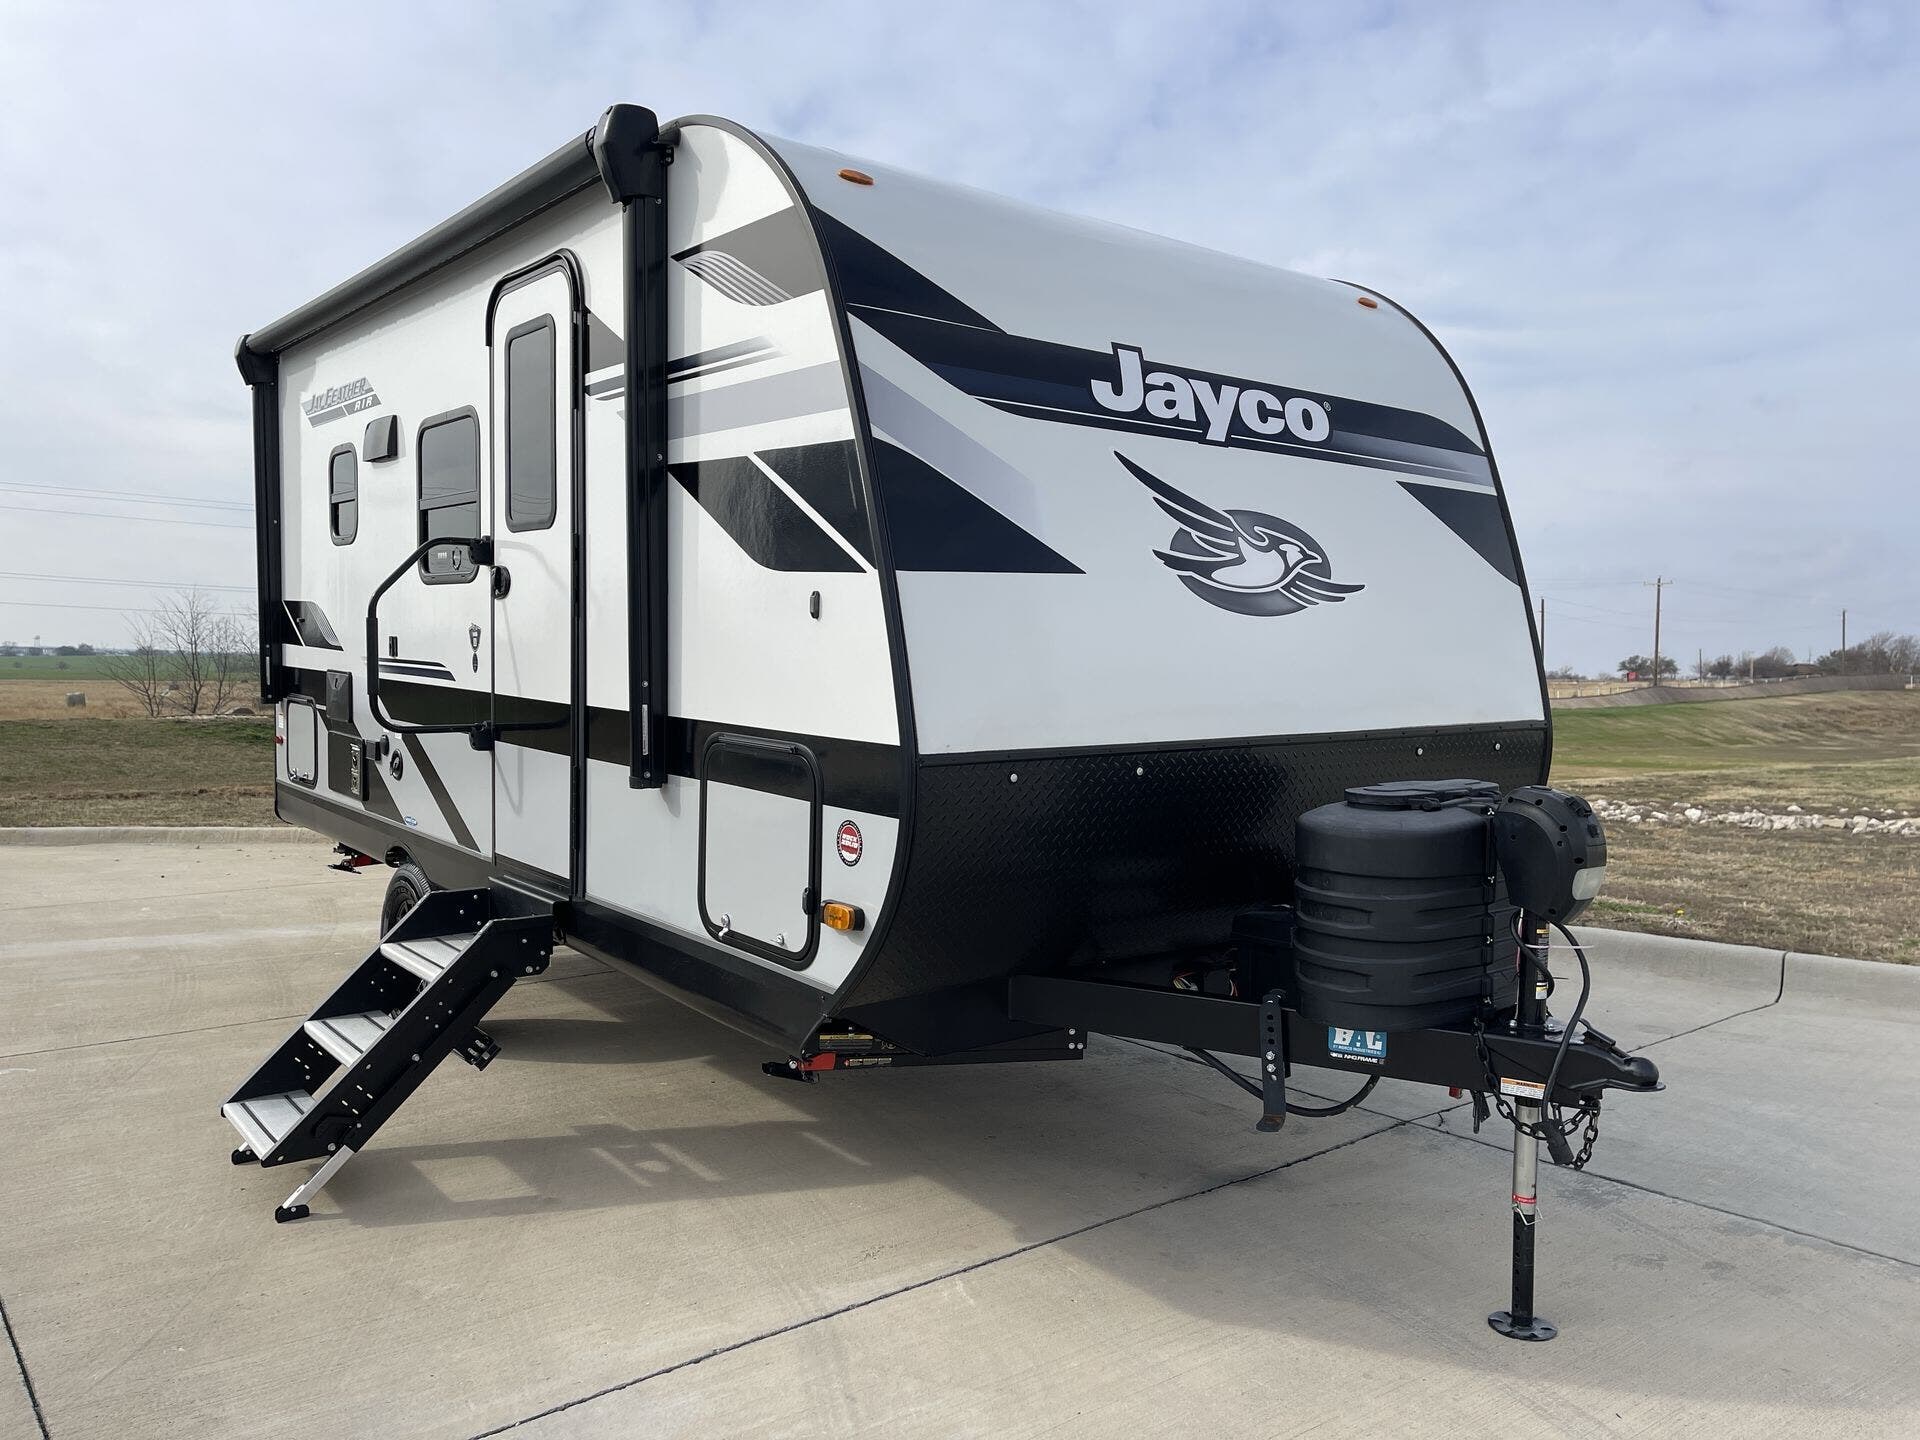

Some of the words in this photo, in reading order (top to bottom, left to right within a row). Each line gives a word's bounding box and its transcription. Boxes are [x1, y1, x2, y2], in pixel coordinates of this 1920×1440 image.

[324, 377, 367, 407] FEATHER
[354, 396, 373, 411] AIR
[1090, 348, 1330, 442] Jayco
[1333, 1027, 1383, 1051] BAL
